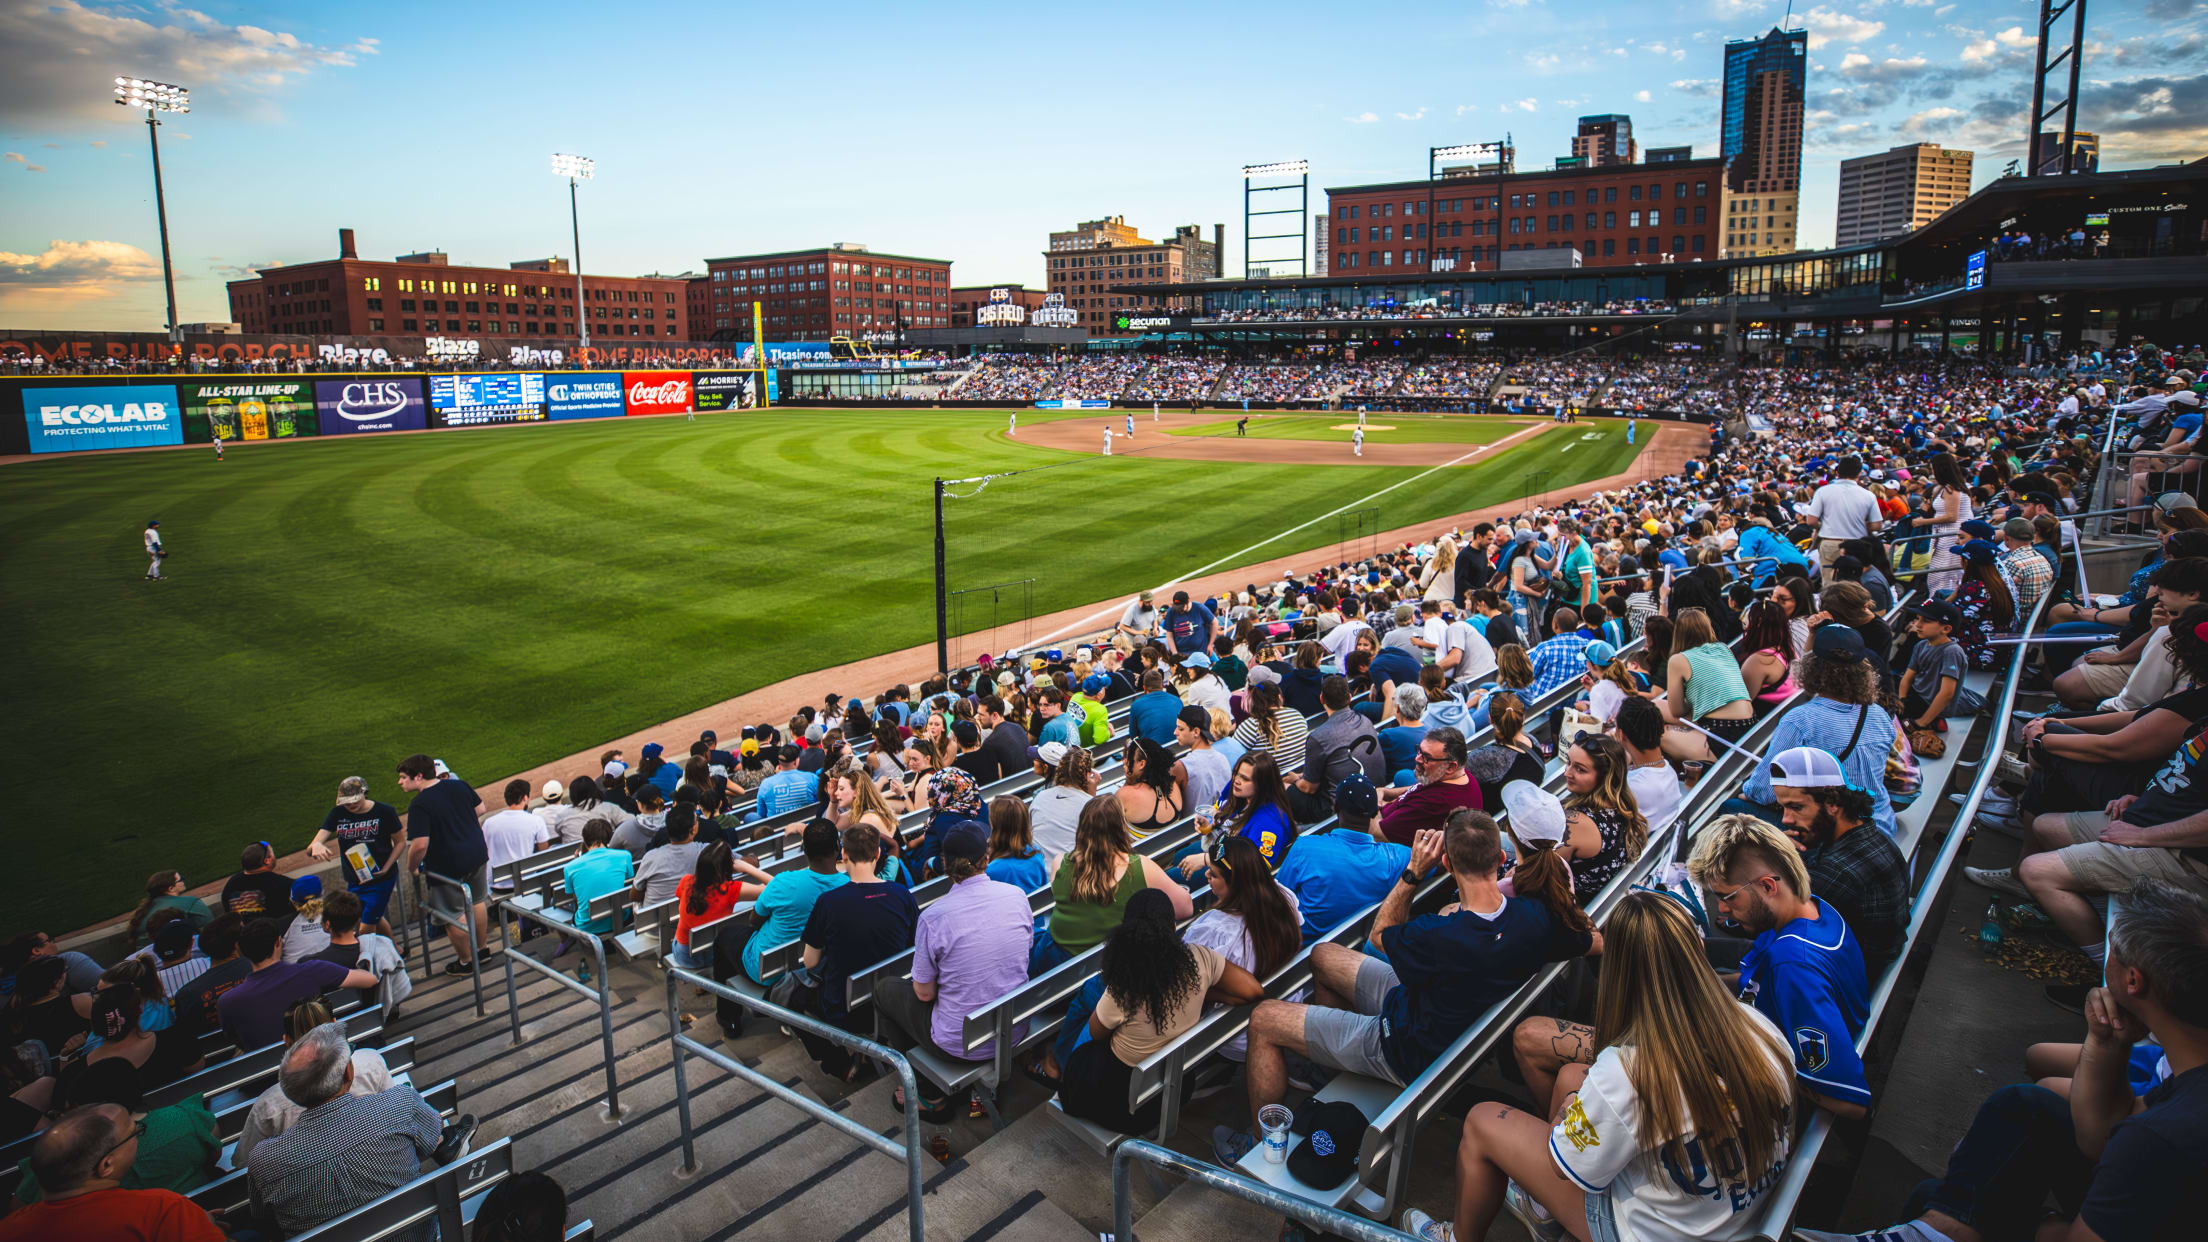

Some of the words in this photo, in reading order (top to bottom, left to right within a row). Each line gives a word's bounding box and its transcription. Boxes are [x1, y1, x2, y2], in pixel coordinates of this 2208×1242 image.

[990, 288, 1009, 298] CHS
[977, 305, 997, 323] CHS
[998, 304, 1025, 322] FIELD
[425, 336, 480, 355] Blaze
[595, 382, 616, 391] CITIES
[709, 376, 743, 385] MORRIE'S
[198, 386, 254, 397] ALL-STAR
[255, 384, 300, 395] LINE-UP
[342, 382, 400, 406] CHS
[570, 391, 620, 401] ORTHOPEDICS
[629, 380, 688, 405] Coca-Cola
[40, 402, 167, 426] ECOLAB
[44, 427, 106, 437] PROTECTING
[107, 425, 141, 434] WHAT'S
[336, 818, 380, 831] OCTOBER
